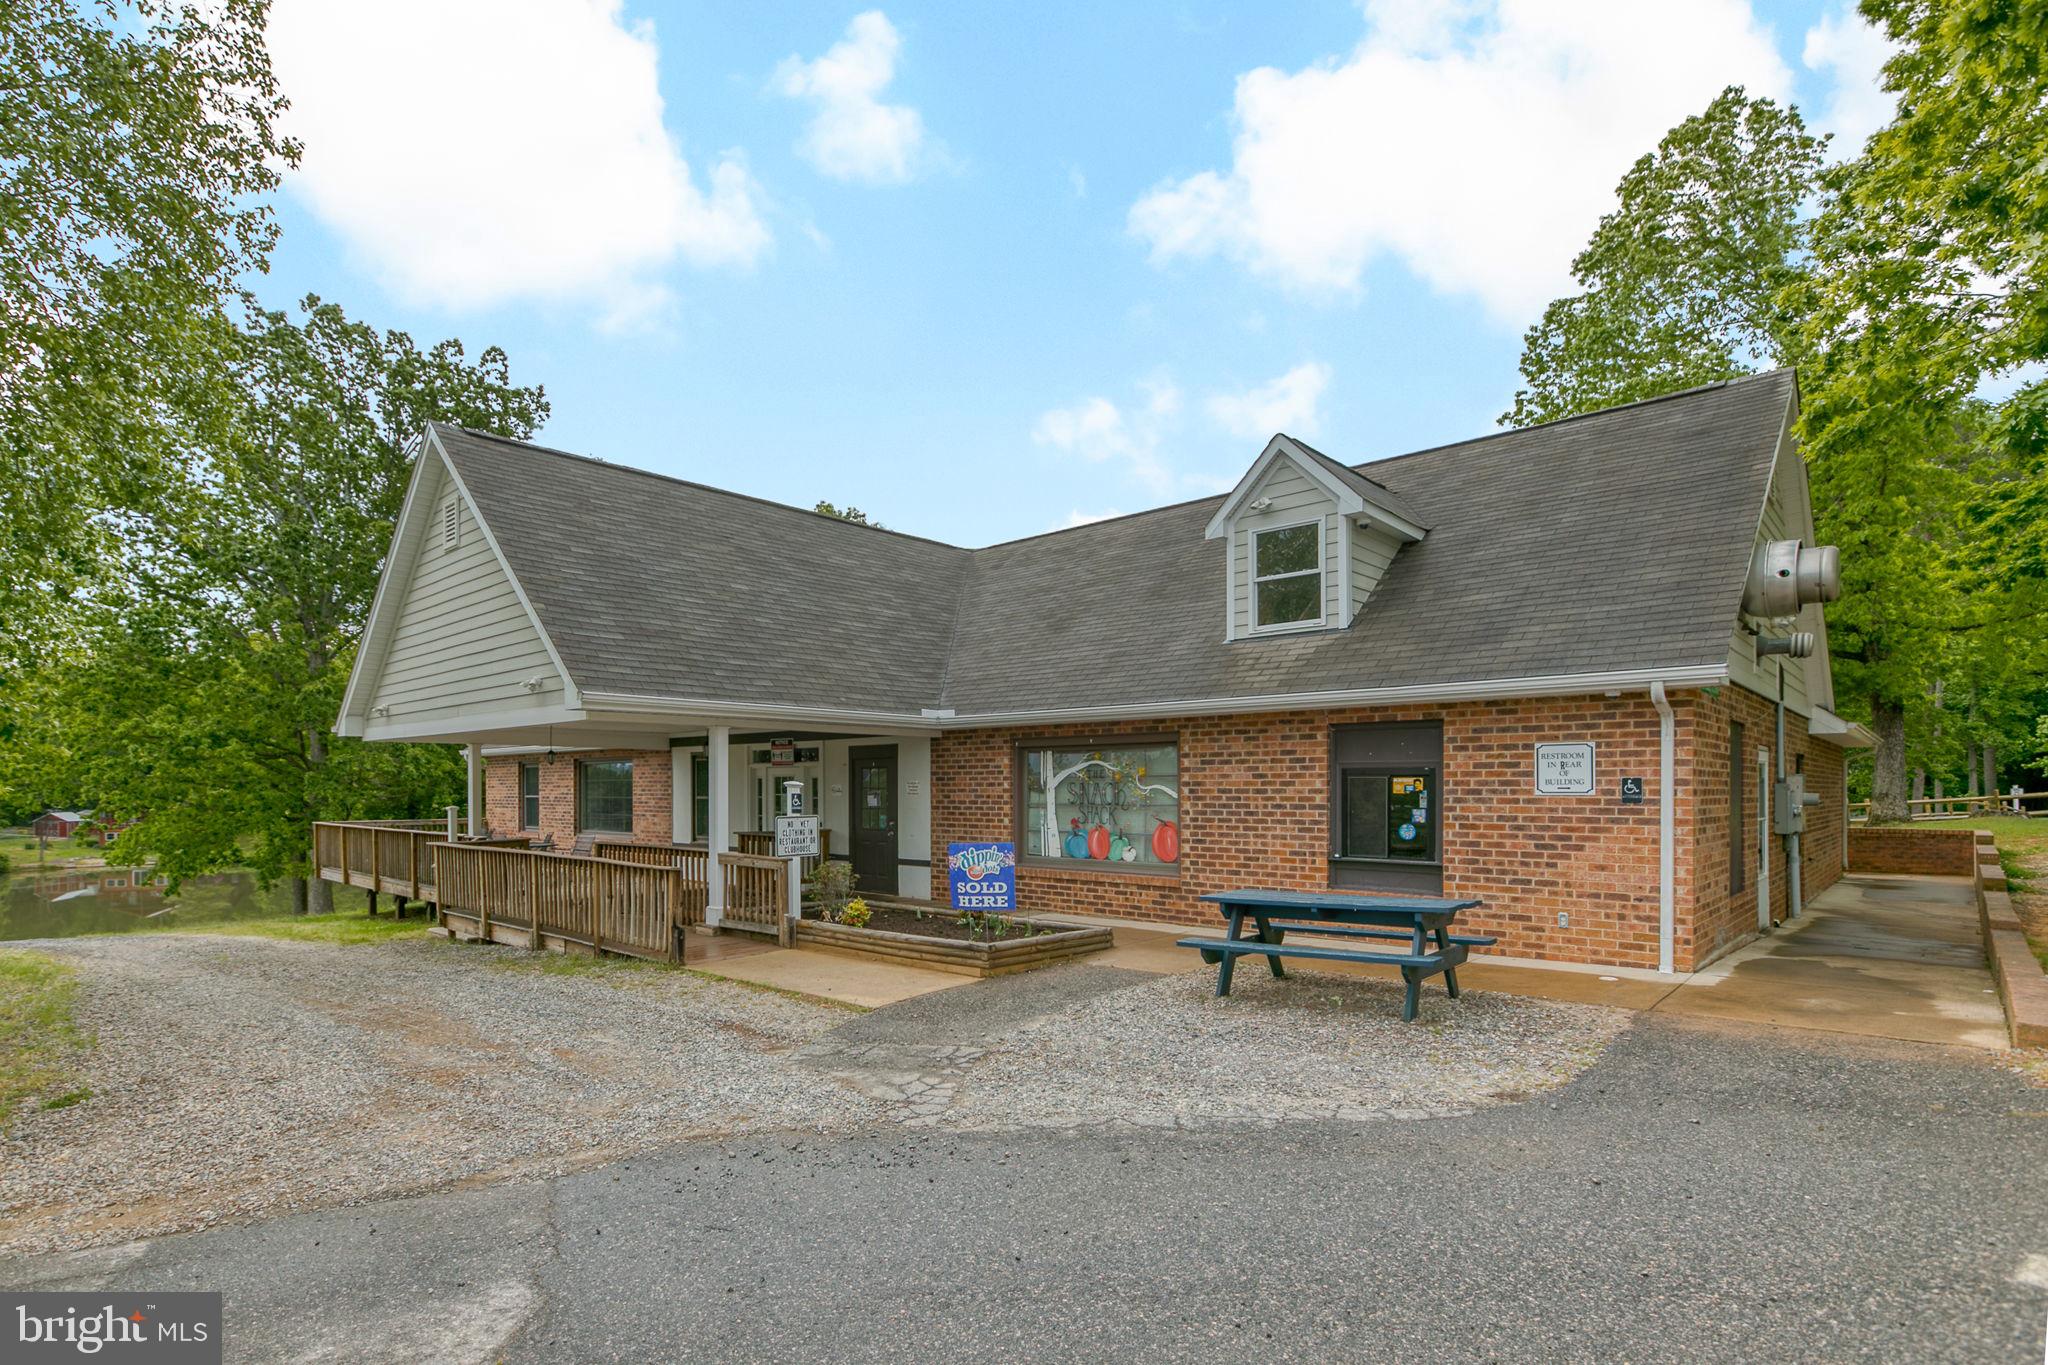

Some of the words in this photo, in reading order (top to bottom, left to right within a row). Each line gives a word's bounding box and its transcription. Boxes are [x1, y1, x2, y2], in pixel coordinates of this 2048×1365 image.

[1540, 752, 1584, 760] RESTROOM
[1560, 761, 1582, 770] REAR
[1545, 778, 1584, 786] BUILDING
[1078, 806, 1118, 825] SHACK
[800, 820, 809, 828] WET
[782, 829, 806, 837] CLOTHING
[779, 837, 808, 846] RESTAURANT
[810, 836, 816, 844] OR
[784, 845, 811, 854] CLUBHOUSE
[957, 882, 1007, 894] SOLD
[958, 895, 1008, 908] HERE
